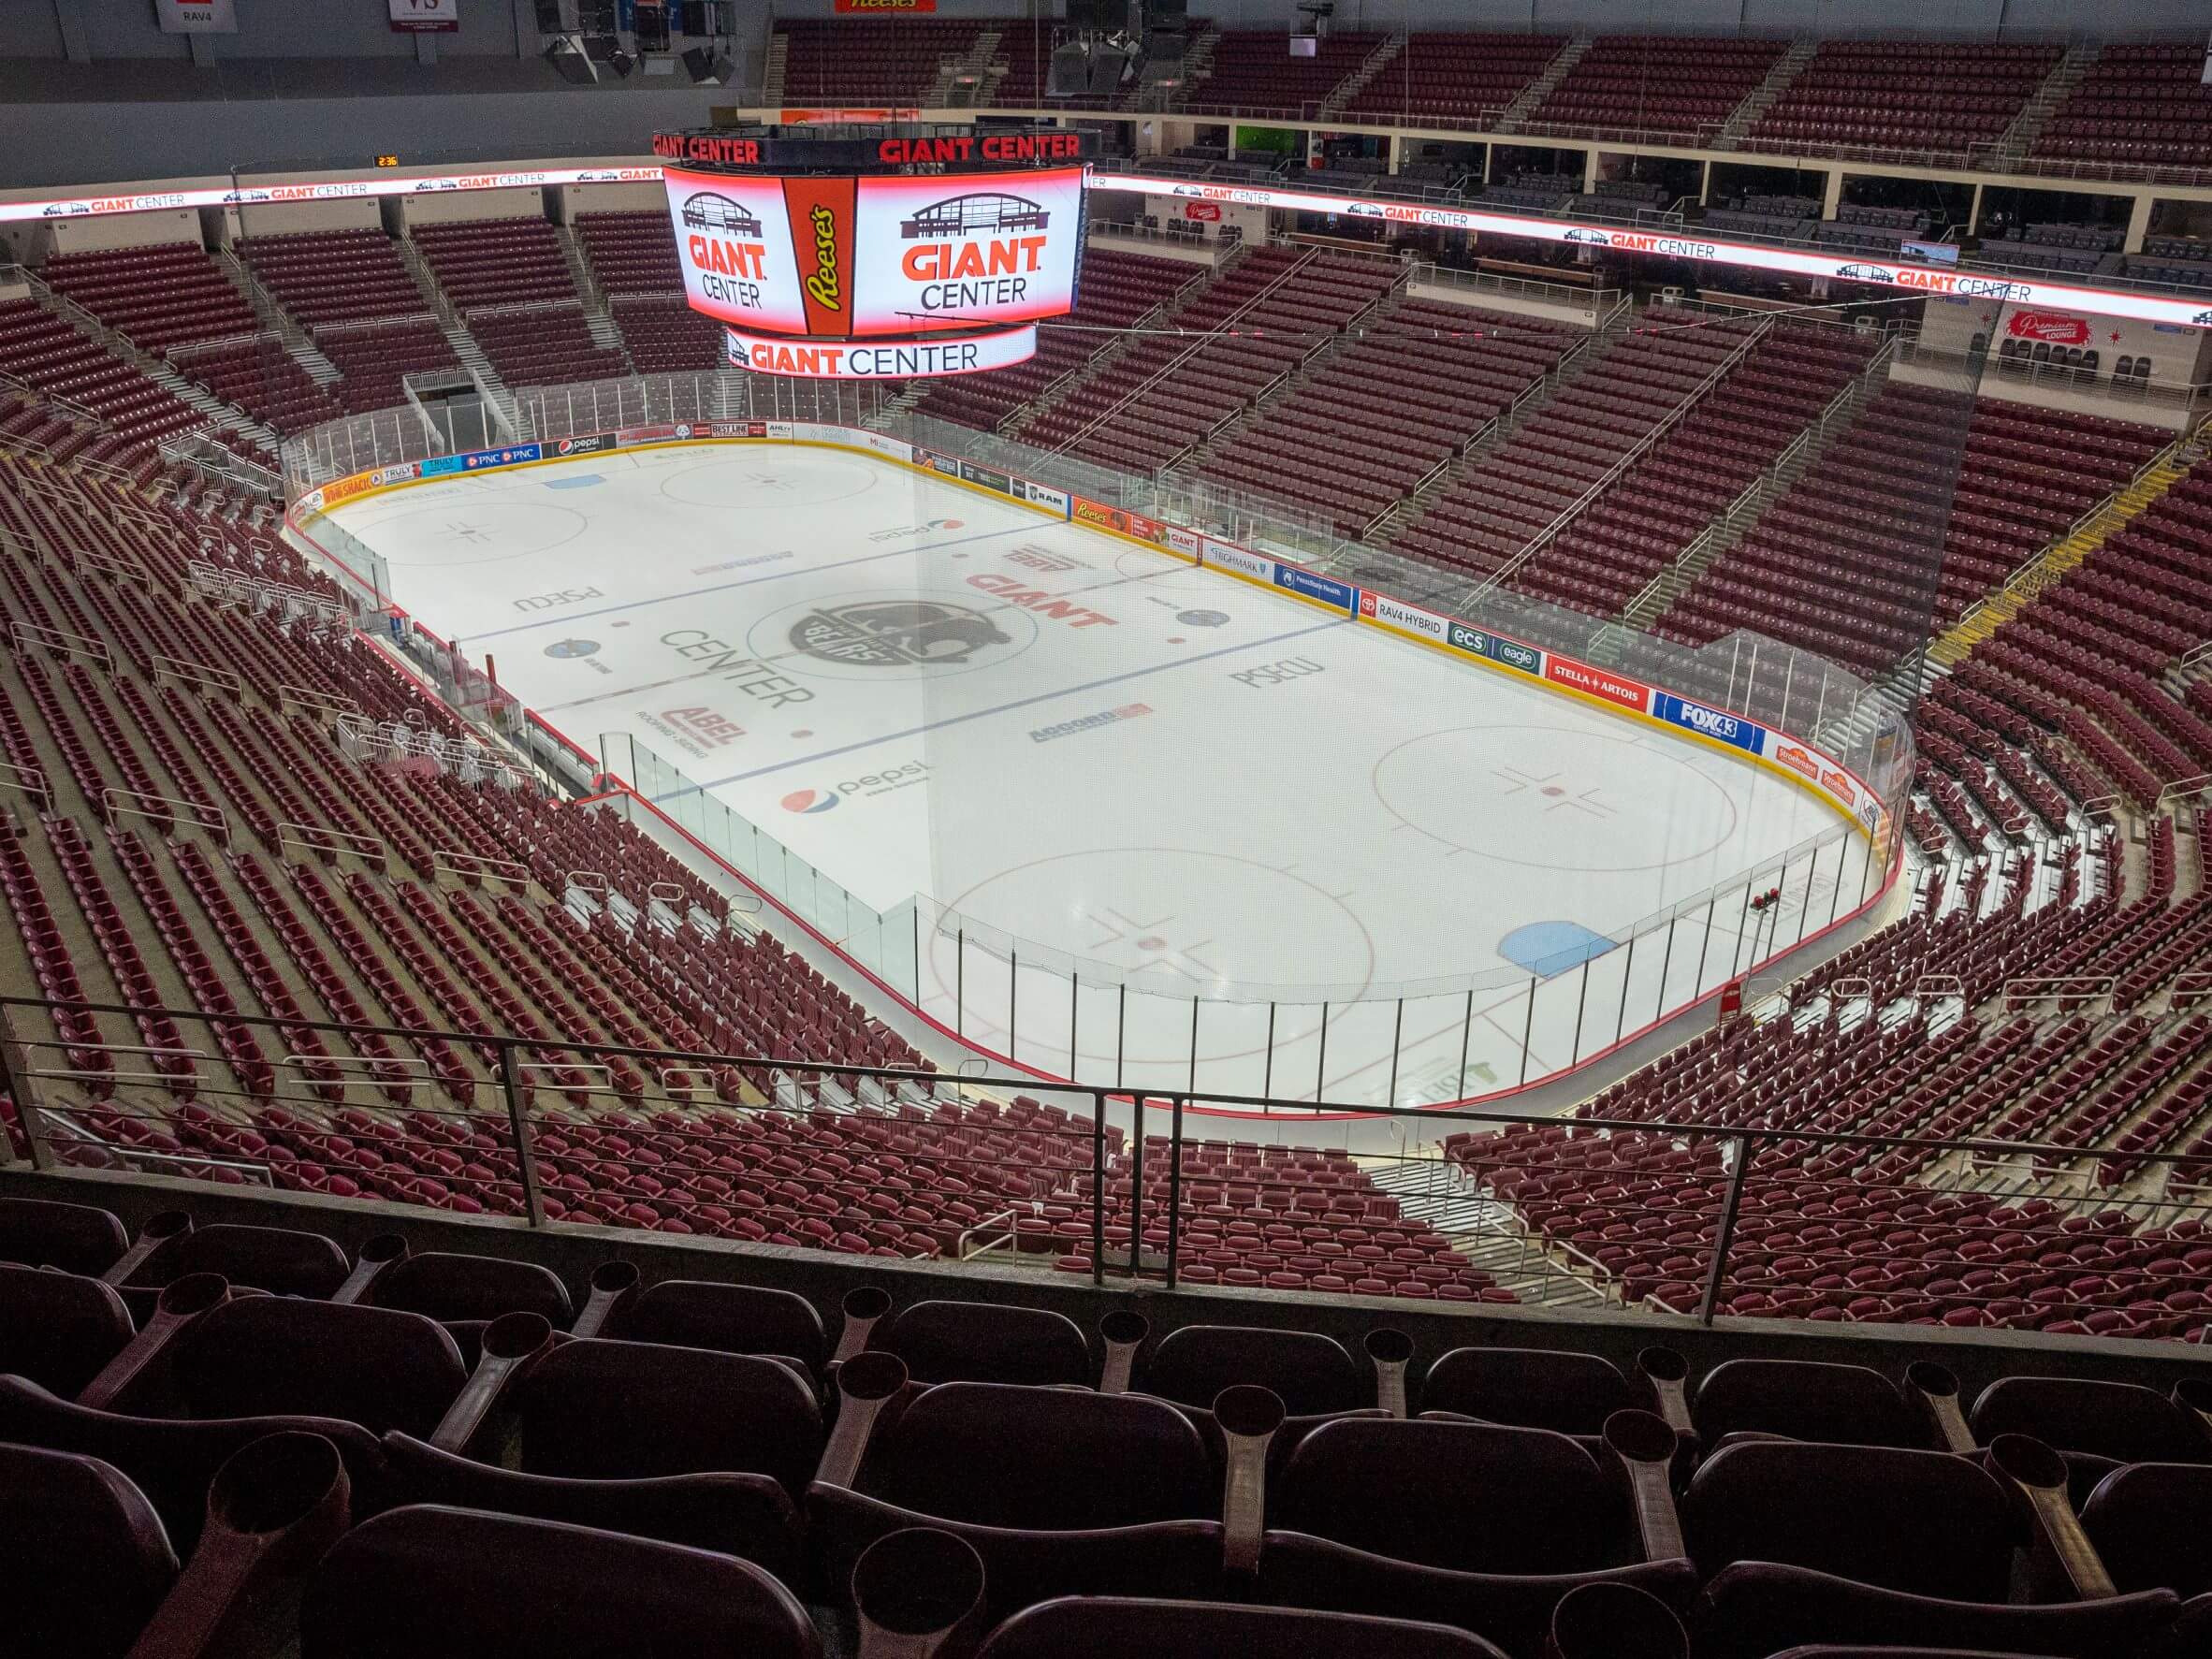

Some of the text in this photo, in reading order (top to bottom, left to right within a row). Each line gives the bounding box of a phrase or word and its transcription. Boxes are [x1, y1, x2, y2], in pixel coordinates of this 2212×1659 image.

[182, 11, 212, 23] RAV4
[653, 134, 759, 164] GIANT CENTER
[879, 135, 1079, 163] GIANT CENTER
[458, 173, 546, 188] GIANT CENTER
[619, 169, 659, 180] GIANT
[271, 183, 368, 199] GIANT CENTER
[1203, 188, 1271, 203] GIANT CENTER
[91, 194, 185, 212] GIANT CENTER
[1385, 207, 1468, 226] GIANT CENTER
[689, 234, 766, 281] GIANT
[807, 203, 842, 312] Reese's
[1611, 234, 1715, 259] GIANT CENTER
[901, 235, 1046, 282] GIANT
[703, 273, 763, 310] CENTER
[921, 277, 1026, 311] CENTER
[1897, 270, 2031, 302] GIANT CENTER
[2019, 314, 2078, 335] Premium
[2045, 330, 2076, 340] LOUNGE
[751, 343, 978, 375] GIANT CENTER
[712, 425, 730, 434] BEST
[513, 449, 534, 459] PNC
[574, 437, 600, 449] pepsi
[429, 456, 454, 467] TRULY
[479, 454, 501, 465] PNC
[384, 465, 411, 477] TRULY
[1039, 491, 1063, 506] RAM
[1077, 502, 1107, 524] Reese's
[1171, 533, 1194, 546] GIANT
[966, 574, 1119, 628] GIANT
[1379, 604, 1441, 633] RAV4 HYBRID
[1504, 646, 1533, 664] eagle
[660, 630, 815, 709] CENTER
[1228, 656, 1325, 689] PSECU
[1554, 665, 1638, 702] STELLA ARTOIS
[661, 706, 748, 747] ABEL
[1780, 748, 1816, 773] Stroehmann
[837, 760, 931, 795] pepsi
